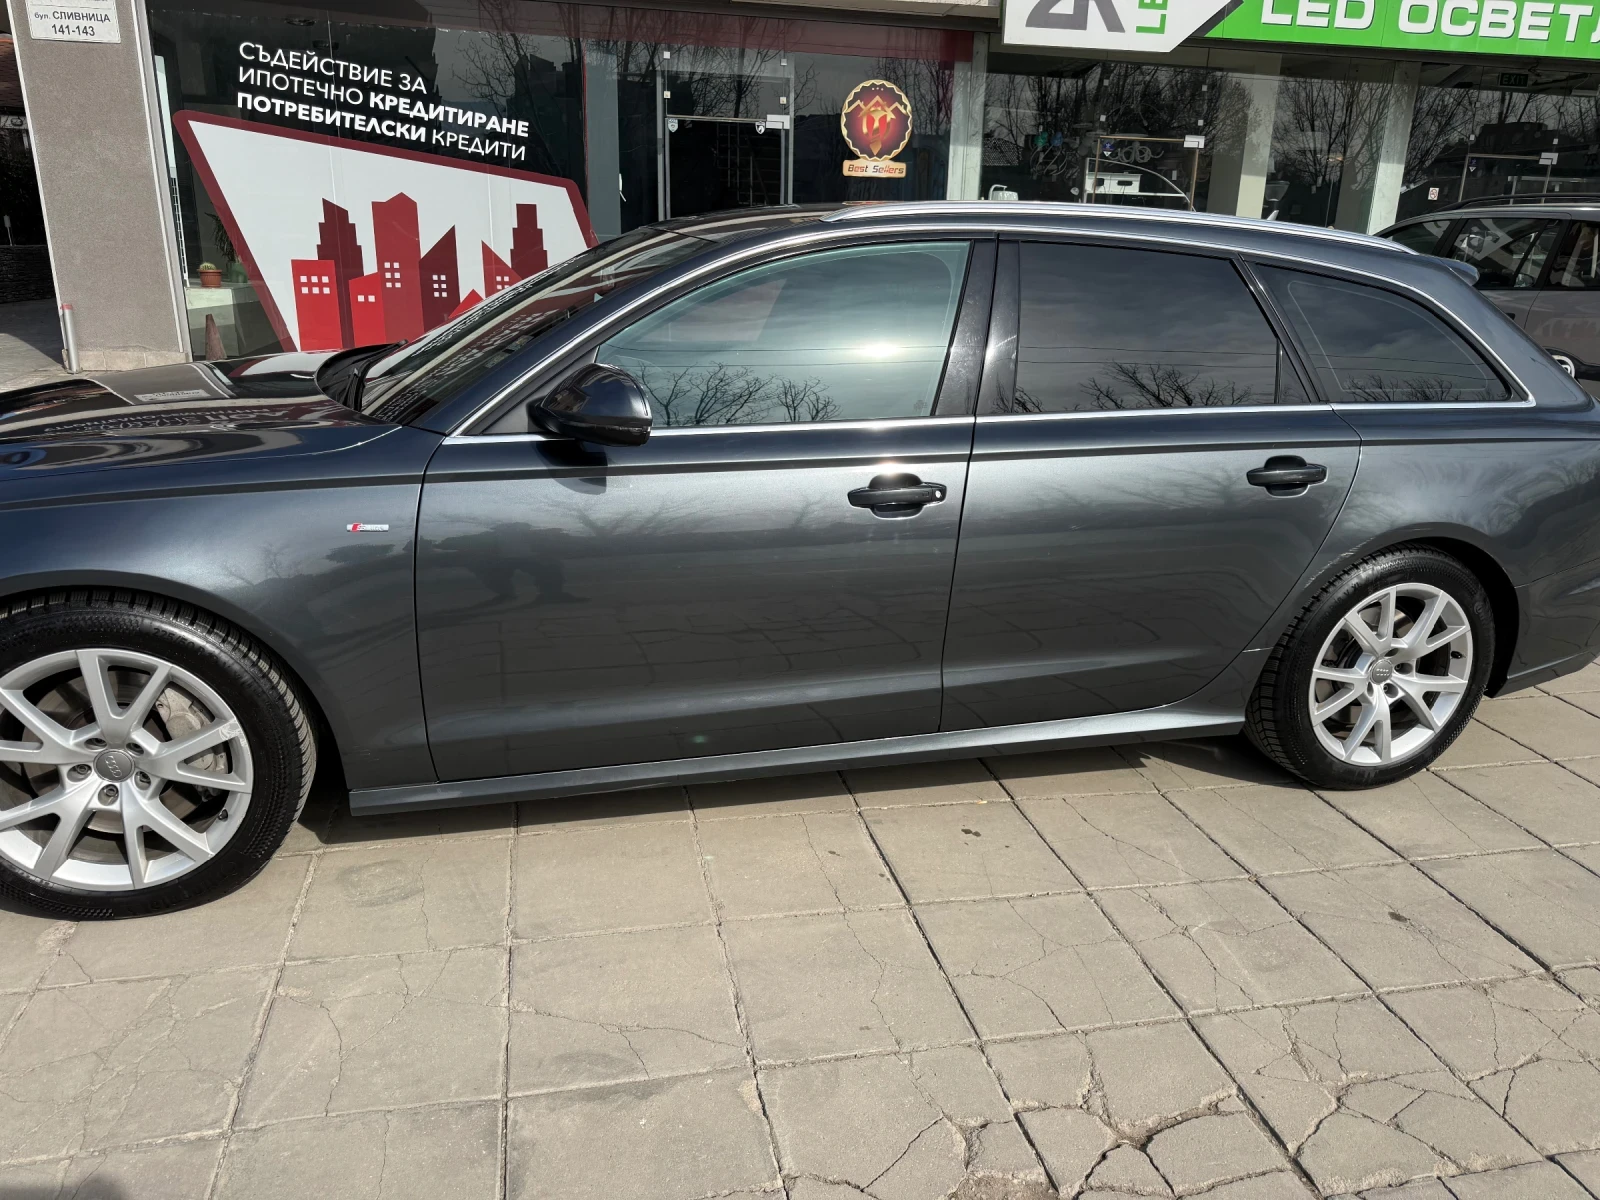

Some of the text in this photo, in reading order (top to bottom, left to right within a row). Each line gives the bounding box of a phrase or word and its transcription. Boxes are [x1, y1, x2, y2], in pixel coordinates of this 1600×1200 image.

[52, 10, 111, 23] СЛИВНИЦА
[1261, 0, 1375, 30] LED
[51, 24, 96, 36] 141-143
[239, 42, 428, 95] СЪДЕЙСТВИЕ ЗА
[1502, 74, 1526, 85] EXIT
[239, 66, 529, 137] ИПОТЕЧНО КРЕДИТИРАНЕ
[237, 92, 526, 161] ПОТРЕБИТЕЛСКИ КРЕДИТИ
[847, 164, 905, 174] Best Sellers
